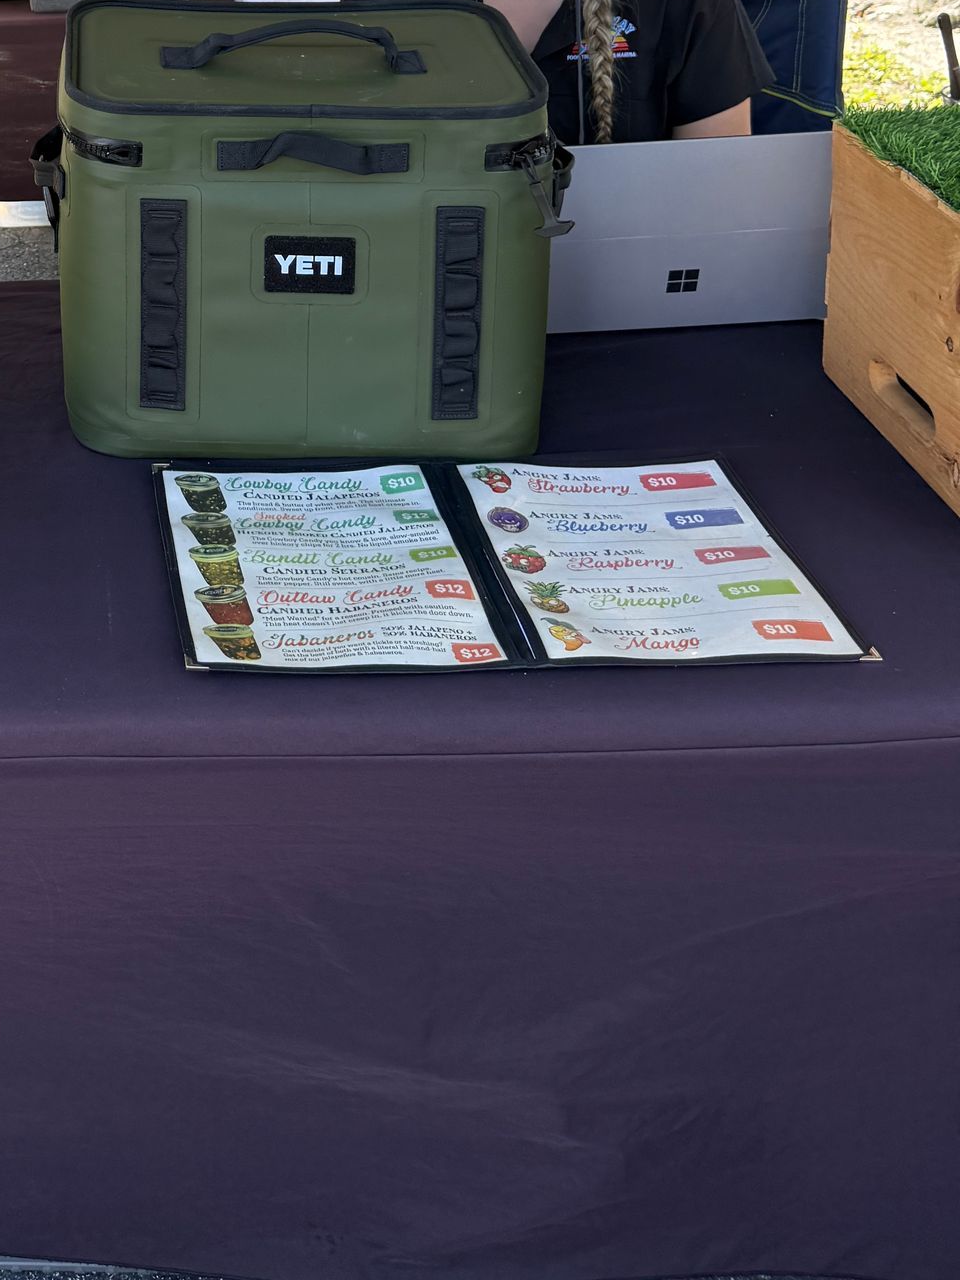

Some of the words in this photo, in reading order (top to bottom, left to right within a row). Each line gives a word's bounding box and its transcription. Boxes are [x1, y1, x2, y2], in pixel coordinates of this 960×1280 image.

[274, 254, 343, 276] YETI
[511, 468, 559, 481] ANGRY
[224, 476, 298, 493] Cowboy
[298, 476, 369, 493] Candy
[387, 476, 415, 489] $10
[527, 477, 637, 496] Strawberry
[647, 475, 677, 488] $10
[244, 491, 303, 501] CANDIED
[307, 491, 380, 501] JALAPENOS
[254, 512, 306, 521] Smoked
[401, 512, 429, 520] $12
[530, 510, 578, 520] ANGRY
[674, 513, 705, 525] $10
[234, 517, 310, 532] Cowboy
[310, 515, 383, 532] Candy
[547, 518, 656, 535] Blueberry
[242, 549, 321, 566] Bandit
[324, 552, 400, 568] Candy
[418, 549, 447, 559] $10
[548, 549, 598, 558] ANGRY
[704, 550, 736, 561] $10
[263, 566, 328, 576] CANDIED
[331, 563, 406, 576] SERRANOS
[566, 556, 683, 572] Raspberry
[434, 584, 466, 596] $12
[569, 584, 622, 594] ANGRY
[728, 584, 760, 596] $10
[257, 590, 336, 606] Outlaw
[343, 585, 421, 606] Candy
[589, 592, 703, 610] Pineapple
[257, 606, 324, 616] CANDIED
[328, 597, 418, 615] HABANEROS
[448, 611, 474, 619] down.
[408, 625, 464, 635] JALAPENO
[591, 626, 645, 637] ANGRY
[763, 624, 797, 635] $10
[262, 630, 376, 650] Jabaneros
[410, 631, 477, 641] HABANEROS
[614, 635, 701, 652] Mango
[460, 647, 493, 659] $12
